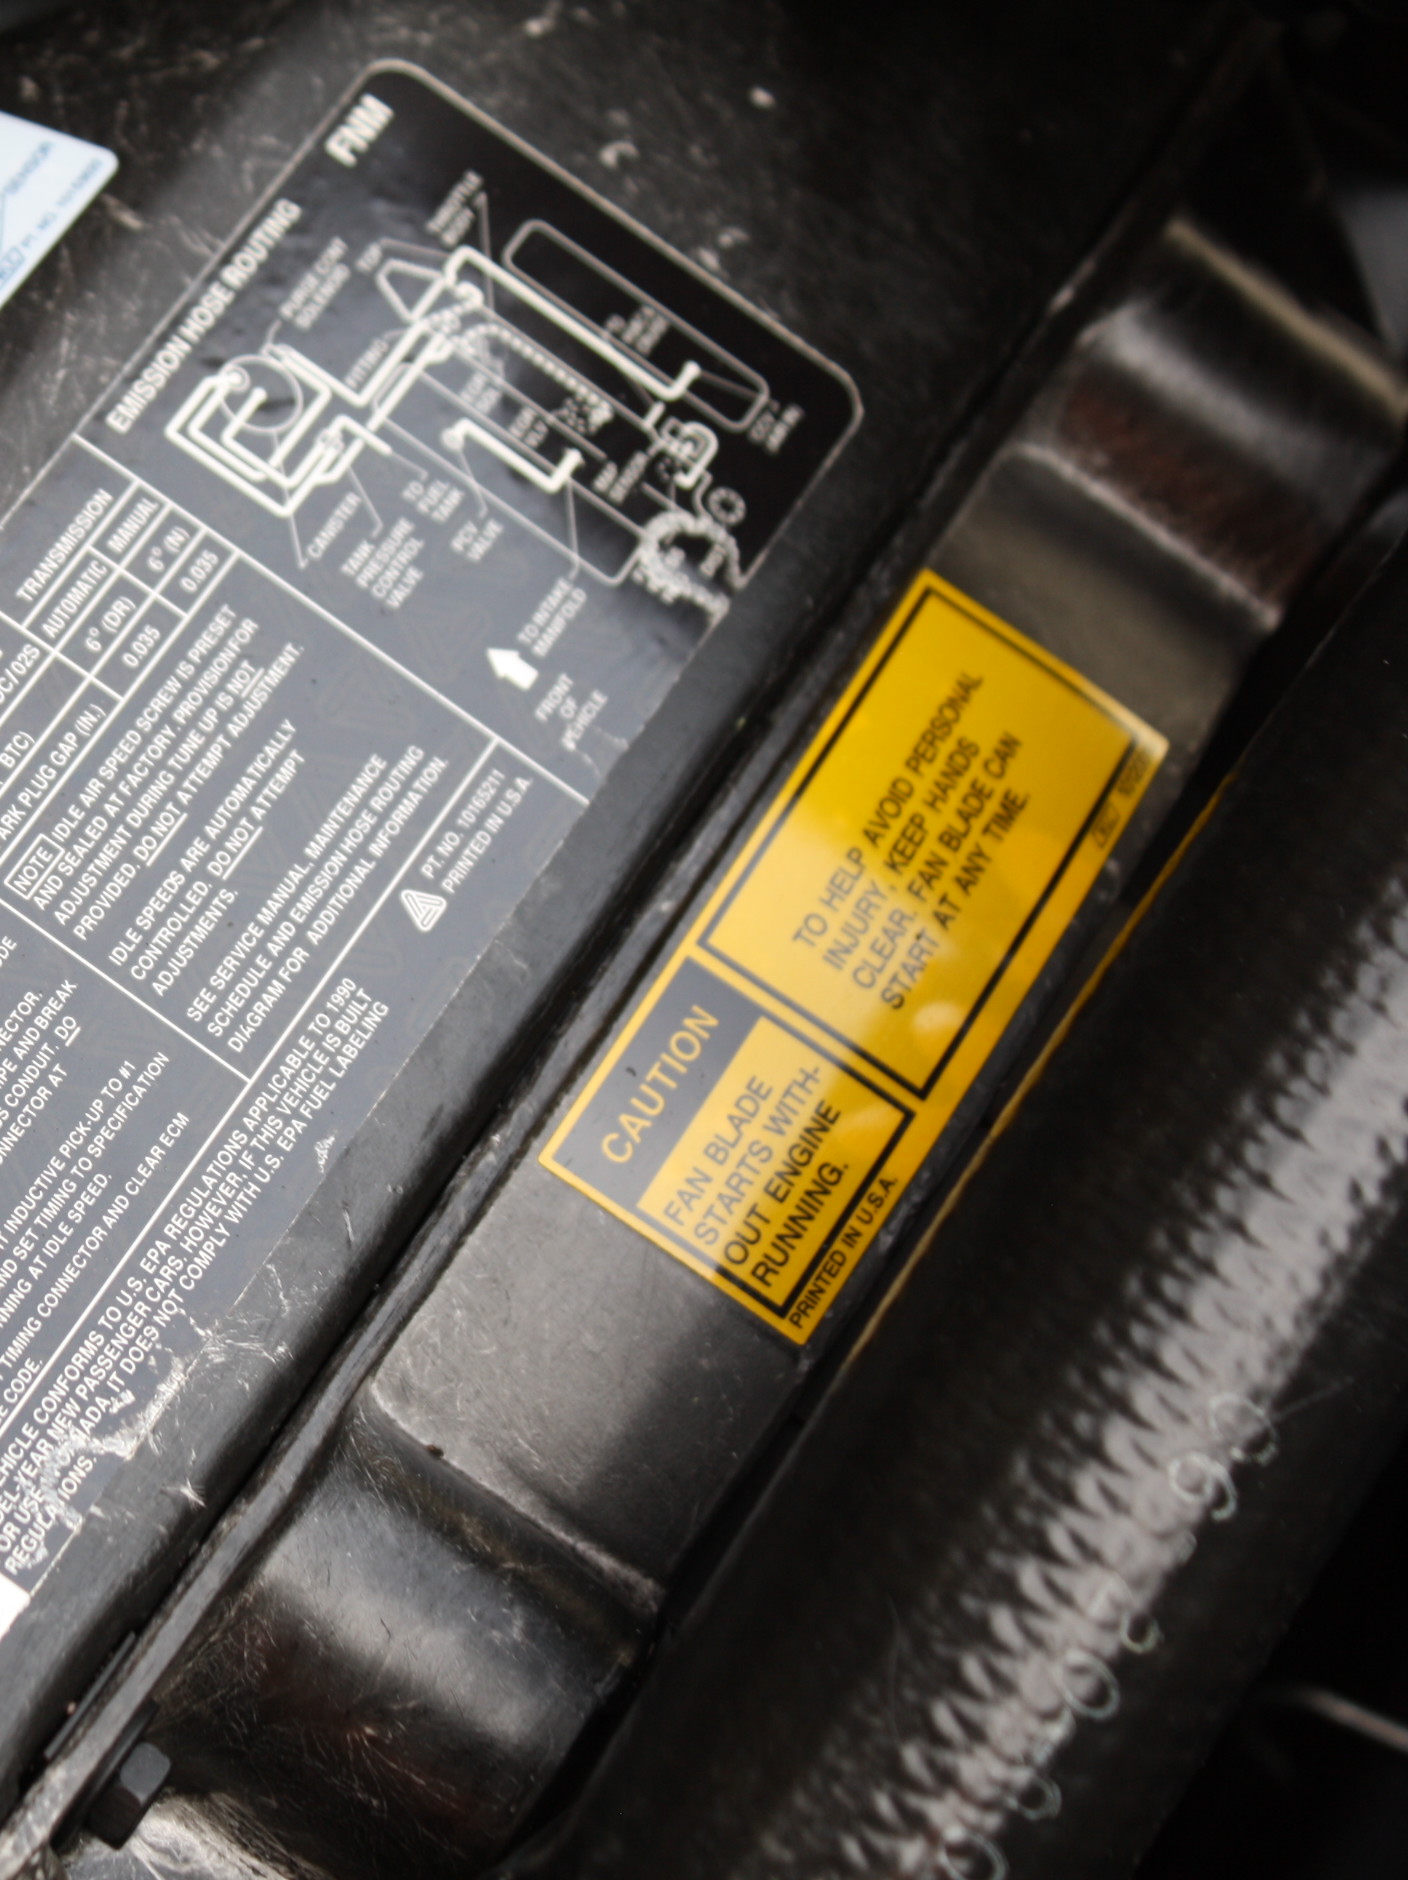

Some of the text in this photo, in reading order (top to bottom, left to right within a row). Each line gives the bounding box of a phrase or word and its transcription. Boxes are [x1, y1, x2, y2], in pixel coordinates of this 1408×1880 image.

[325, 93, 392, 165] FNM
[105, 198, 301, 433] EMISSION HOSE ROUTING
[15, 487, 113, 601] TRANSMISSION
[41, 559, 107, 639] AUTOMATIC
[106, 497, 158, 553] MANUAL
[179, 549, 219, 593] 0.035
[121, 623, 161, 668] 0.035
[16, 763, 57, 808] PLUG
[48, 730, 78, 766] GAP
[73, 702, 110, 737] (IN.)
[419, 767, 505, 879] PT. NO. 10165211
[791, 673, 983, 947] TO HELP AVOID PERSONAL
[107, 718, 296, 966] IDLE SPEEDS ARE AUTOMATICALLY
[129, 748, 305, 980] CONTROLLED. DO NOT ATTEMPT
[440, 829, 492, 894] PRINTED
[483, 812, 504, 833] IN
[821, 736, 980, 971] INJURY, KEEP HANDS
[851, 733, 1021, 990] CLEAR. FAN BLADE CAN
[881, 789, 1028, 1018] START AT ANY TIME.
[150, 887, 238, 997] ADJUSTMENTS.
[600, 1003, 719, 1164] CAUTION
[662, 1074, 773, 1227] FAN BLADE
[692, 1065, 820, 1246] STARTS WITH-
[32, 1329, 105, 1424] CONFORMS
[96, 1305, 122, 1330] TO
[114, 1275, 147, 1307] U.S.
[138, 1239, 172, 1275] EPA
[162, 1128, 248, 1241] REGULATIONS
[241, 1034, 316, 1132] APPLICABLE
[306, 1012, 331, 1035] TO
[325, 976, 357, 1013] 1990
[723, 1100, 842, 1267] OUT ENGINE
[749, 1161, 849, 1288] RUNNING.
[787, 1162, 898, 1329] PRINTED IN U.S.A.
